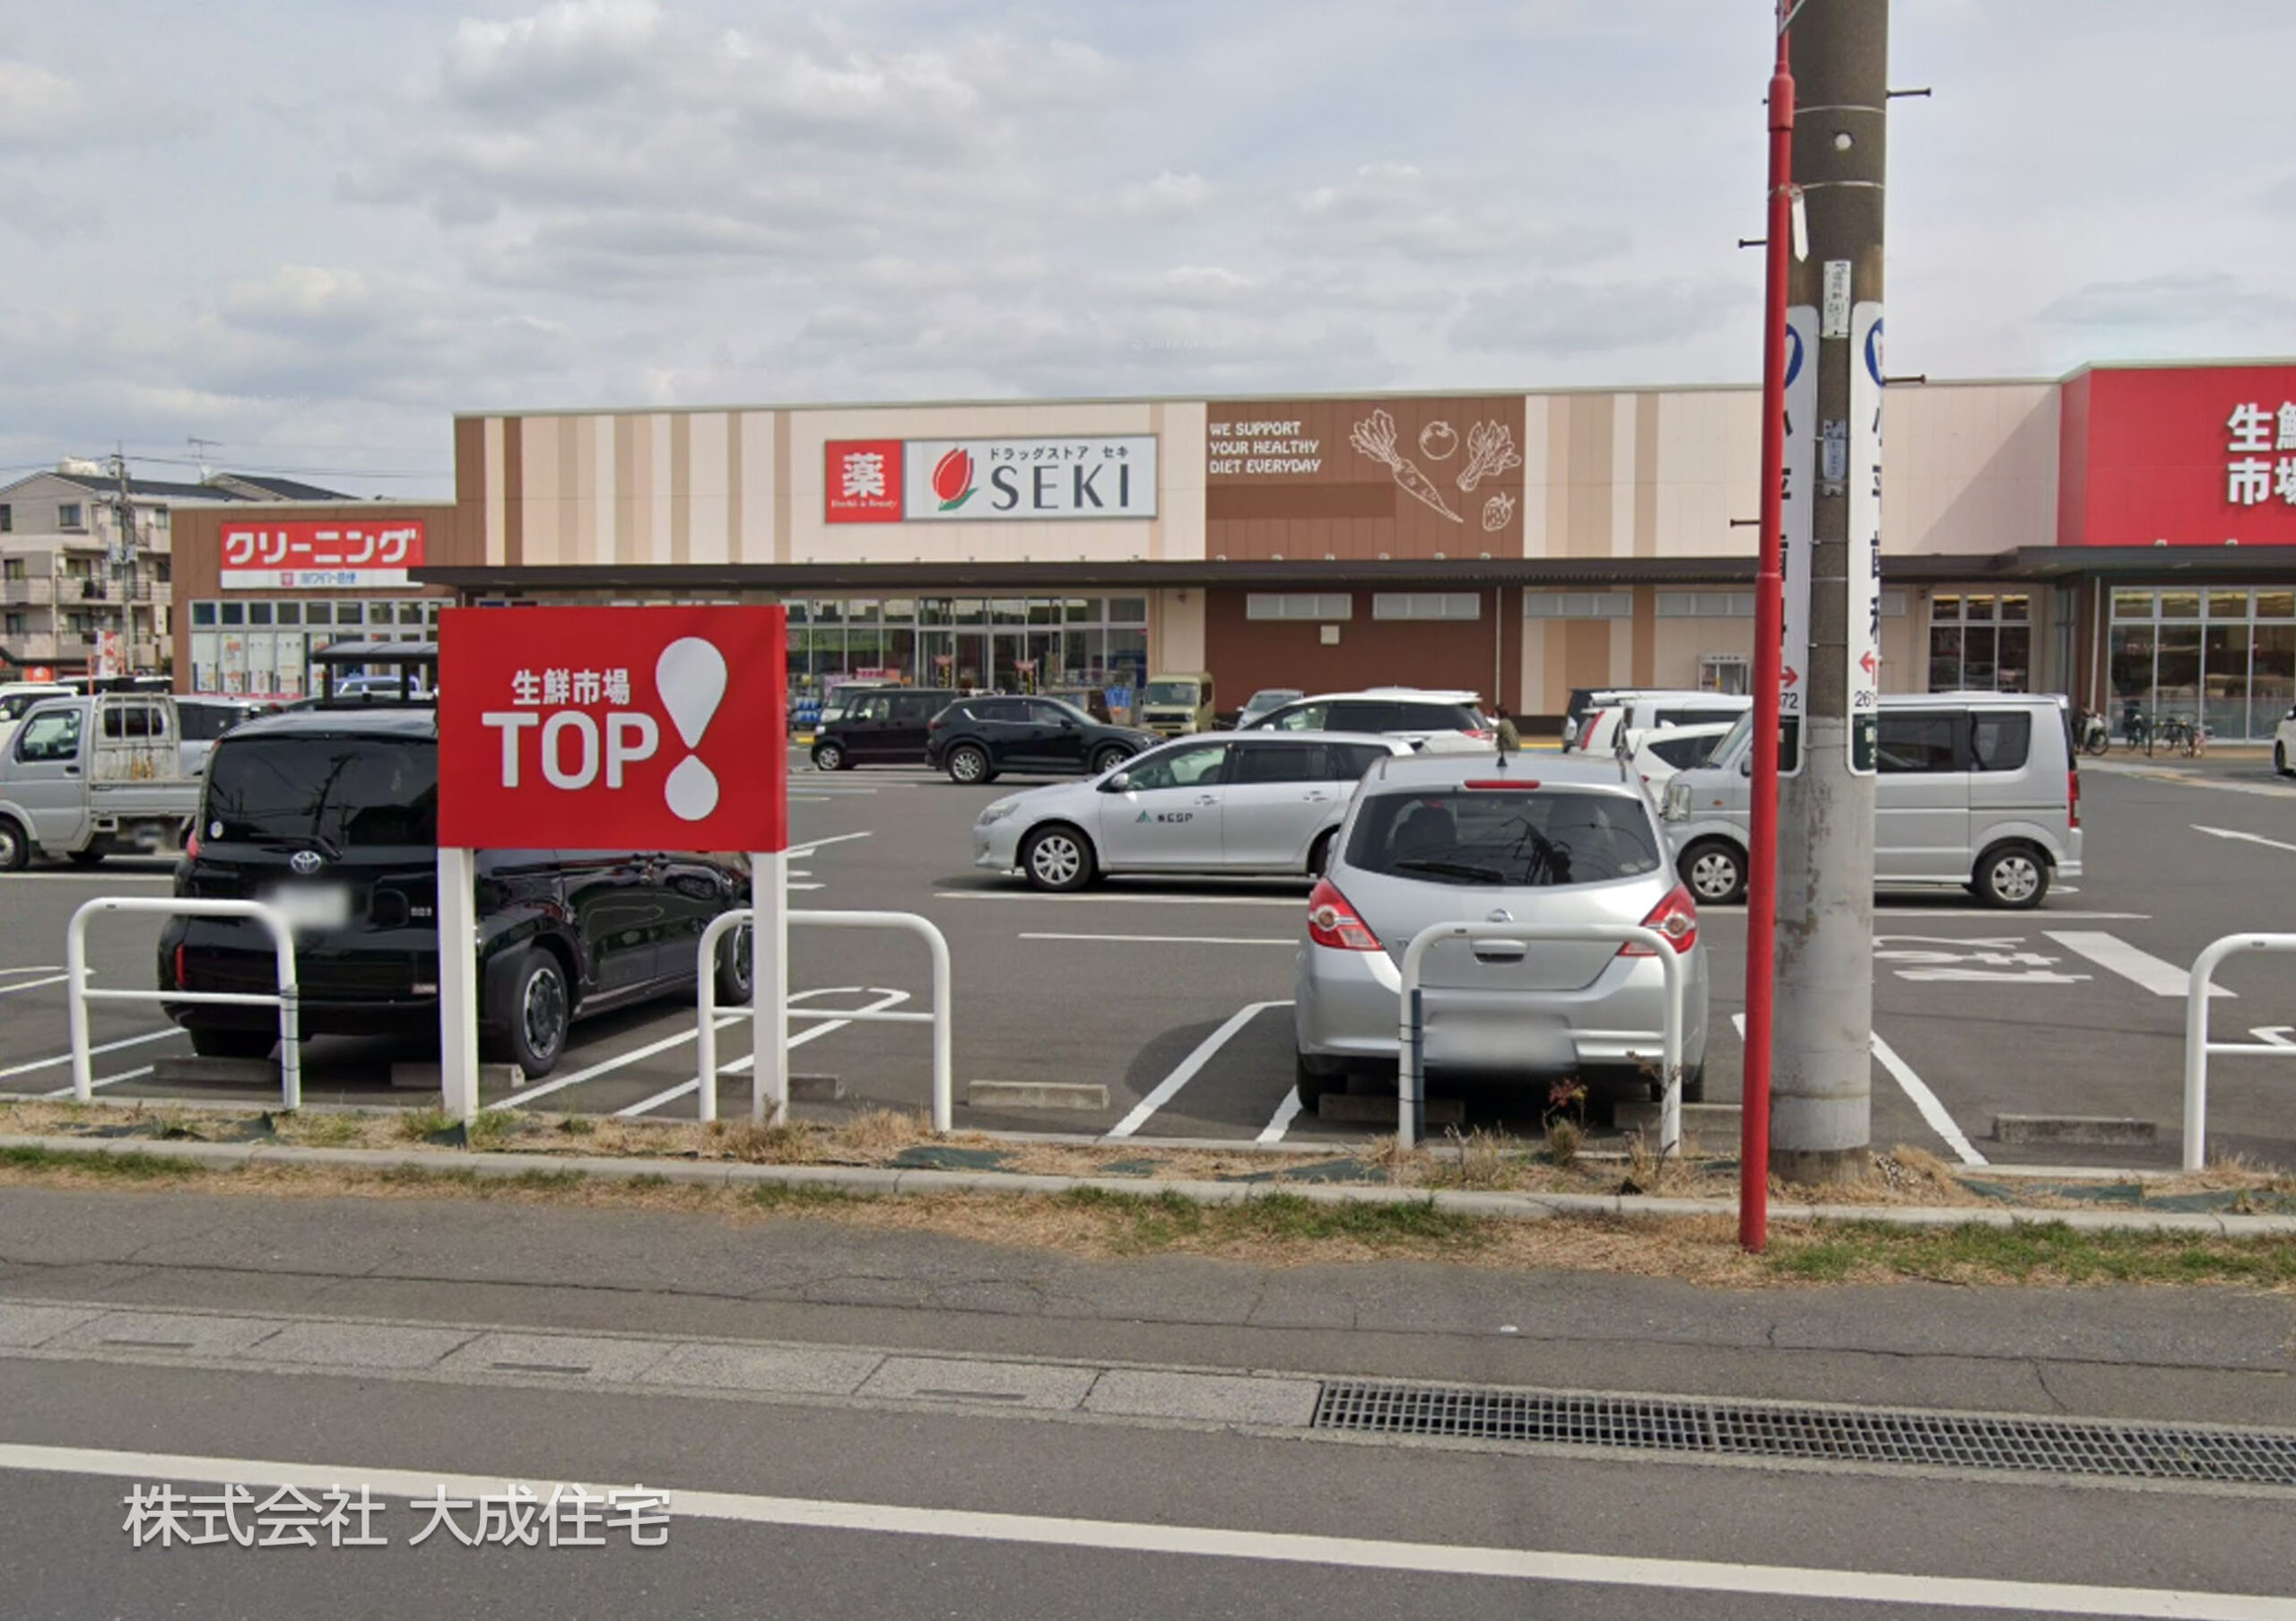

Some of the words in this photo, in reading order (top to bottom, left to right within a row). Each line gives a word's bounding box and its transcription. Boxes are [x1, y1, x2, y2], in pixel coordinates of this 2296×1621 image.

[1209, 423, 1231, 437] WE
[1235, 421, 1301, 437] SUPPORT
[990, 445, 1090, 462] ドラッグストア
[1102, 445, 1129, 460] セキ
[1209, 440, 1249, 456] YOUR
[1253, 440, 1319, 455] HEALTHY
[842, 452, 886, 499] 薬
[1209, 459, 1243, 475] DIET
[1246, 458, 1322, 475] EVERYDAY
[990, 463, 1129, 511] SEKI
[225, 528, 417, 565] クリーニング
[510, 667, 631, 706] 生鮮市場
